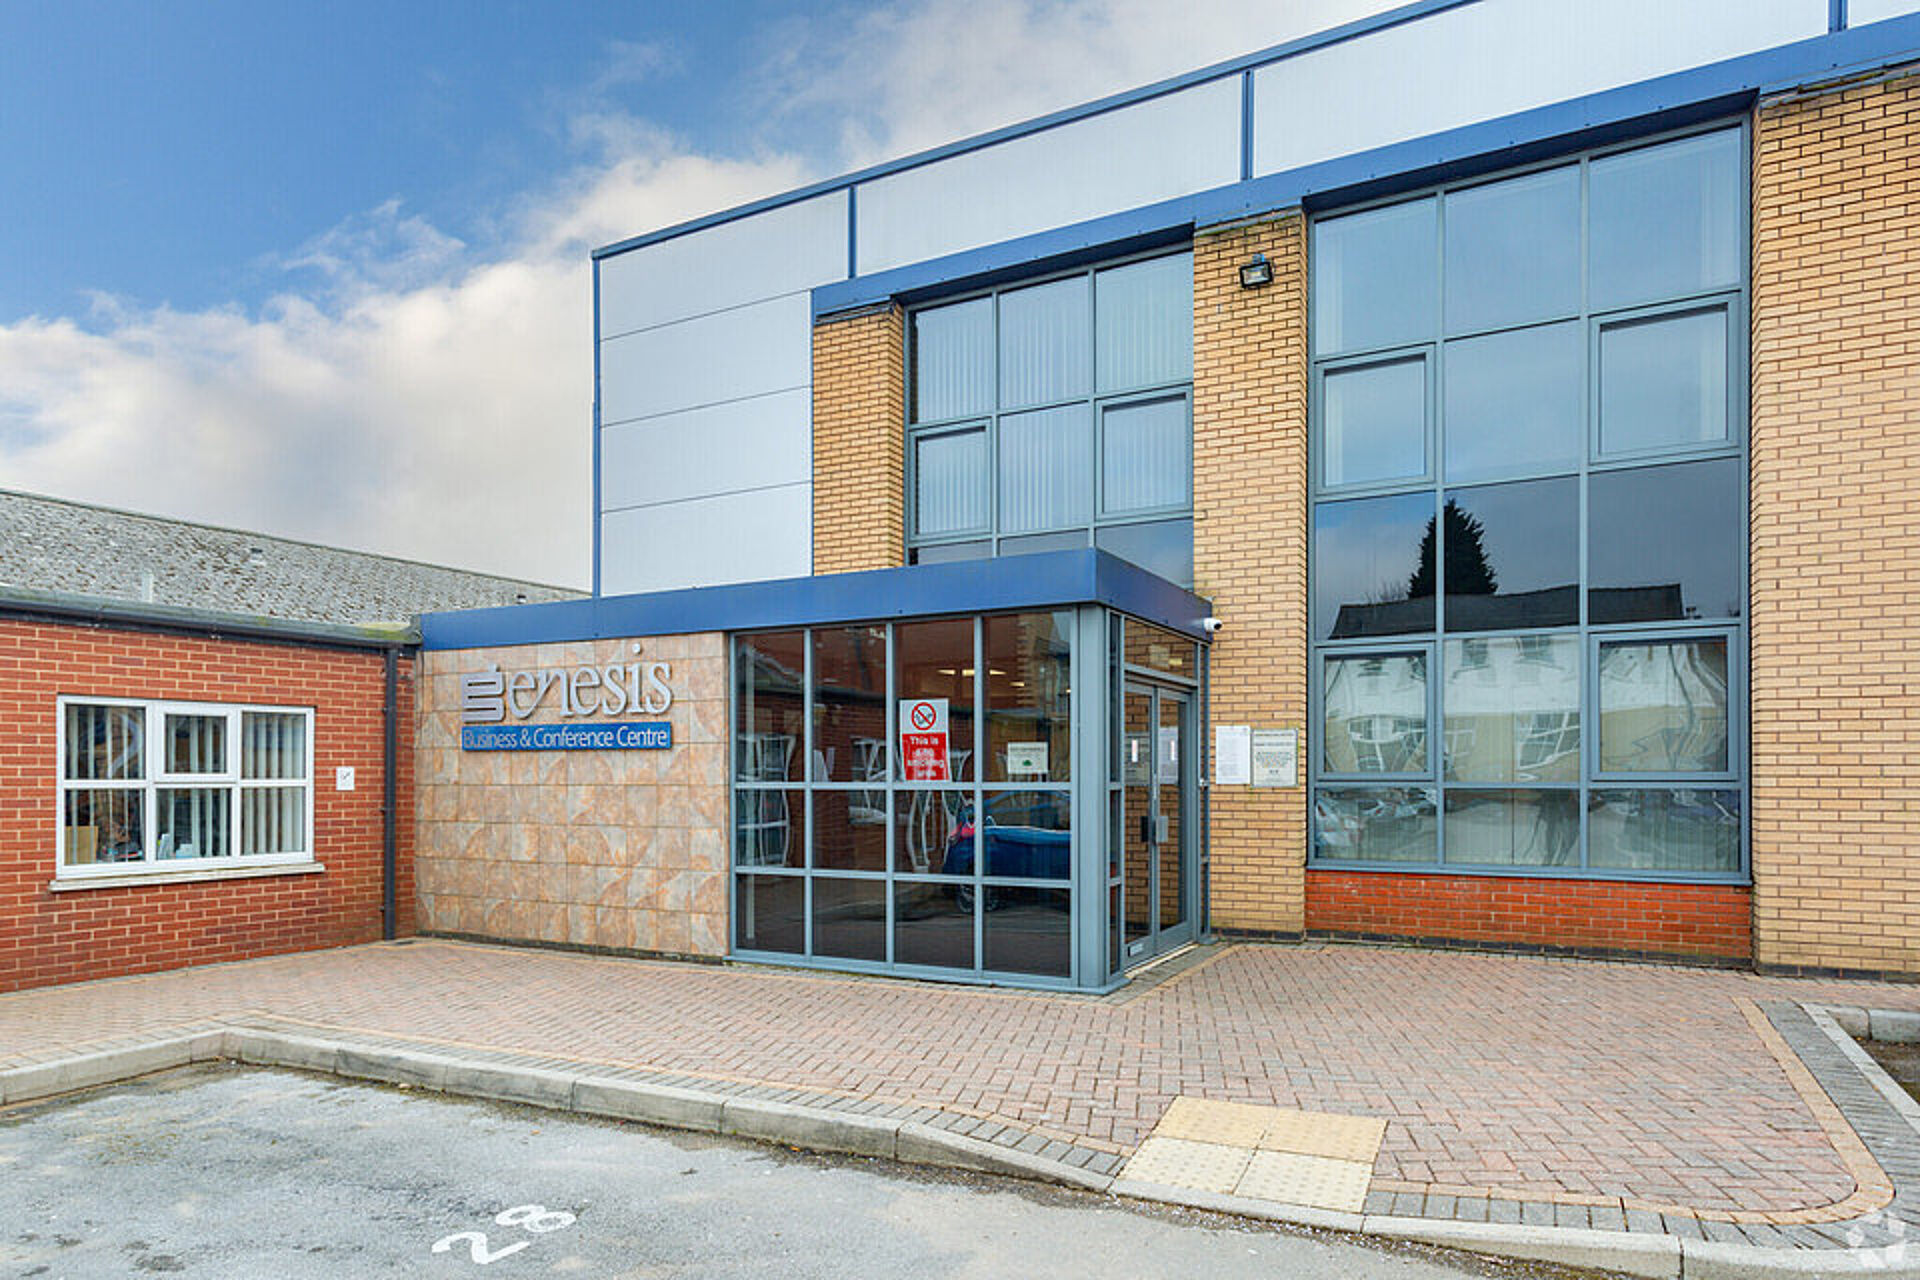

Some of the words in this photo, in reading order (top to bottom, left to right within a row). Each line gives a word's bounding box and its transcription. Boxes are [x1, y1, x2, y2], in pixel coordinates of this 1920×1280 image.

[464, 729, 517, 748] Business
[520, 729, 532, 747] &
[534, 727, 613, 747] Conference
[617, 726, 668, 746] Centre
[431, 1204, 577, 1265] 28
